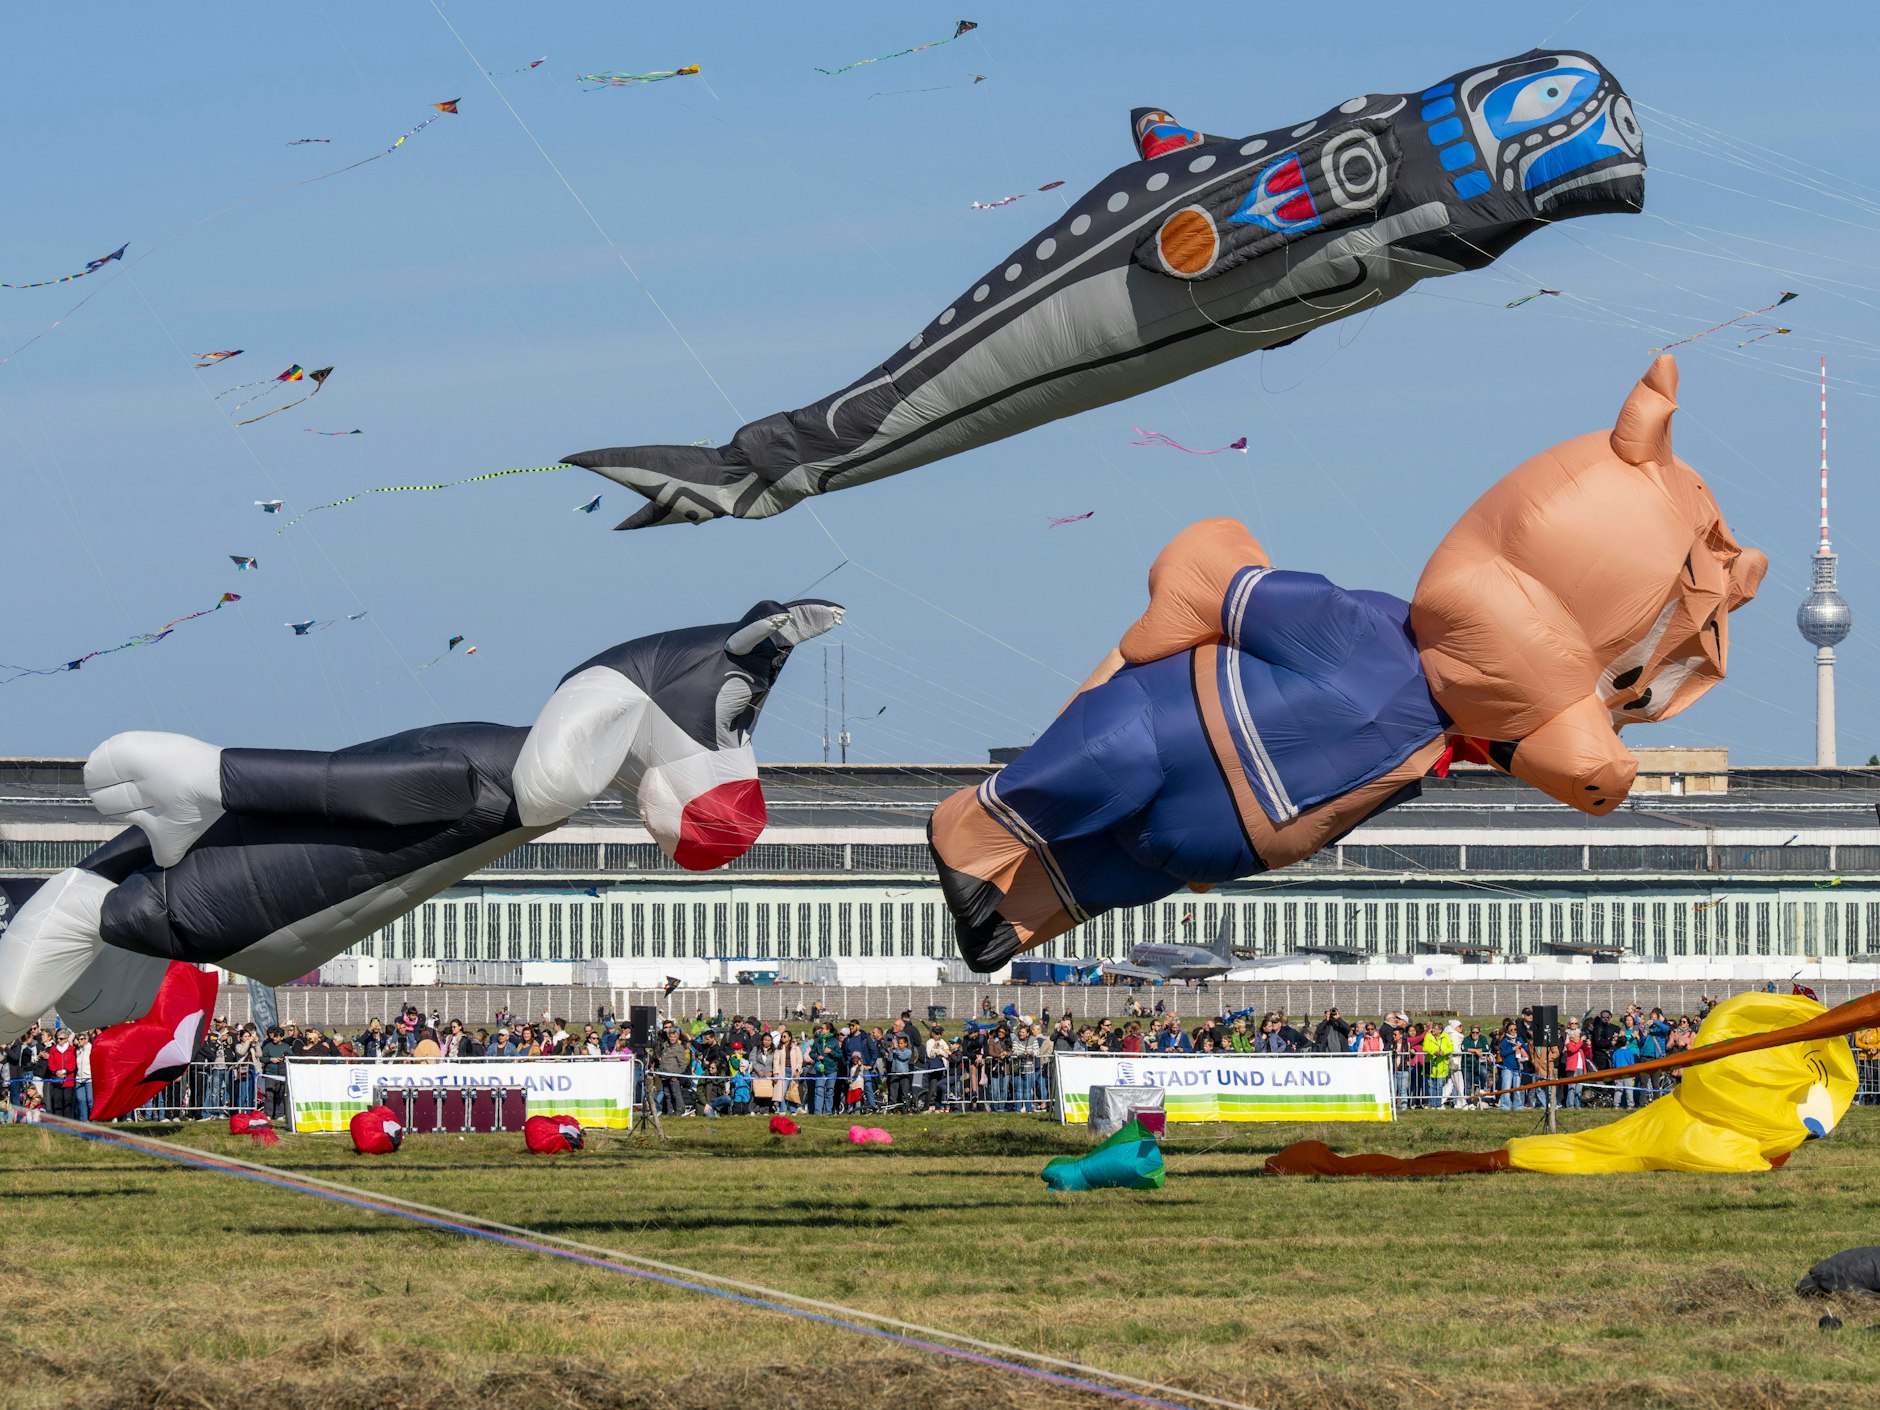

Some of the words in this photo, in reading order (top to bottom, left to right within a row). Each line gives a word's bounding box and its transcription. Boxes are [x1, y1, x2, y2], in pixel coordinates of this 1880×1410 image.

[1142, 1070, 1212, 1087] STADT
[1217, 1070, 1265, 1087] UND
[1271, 1070, 1333, 1087] LAND
